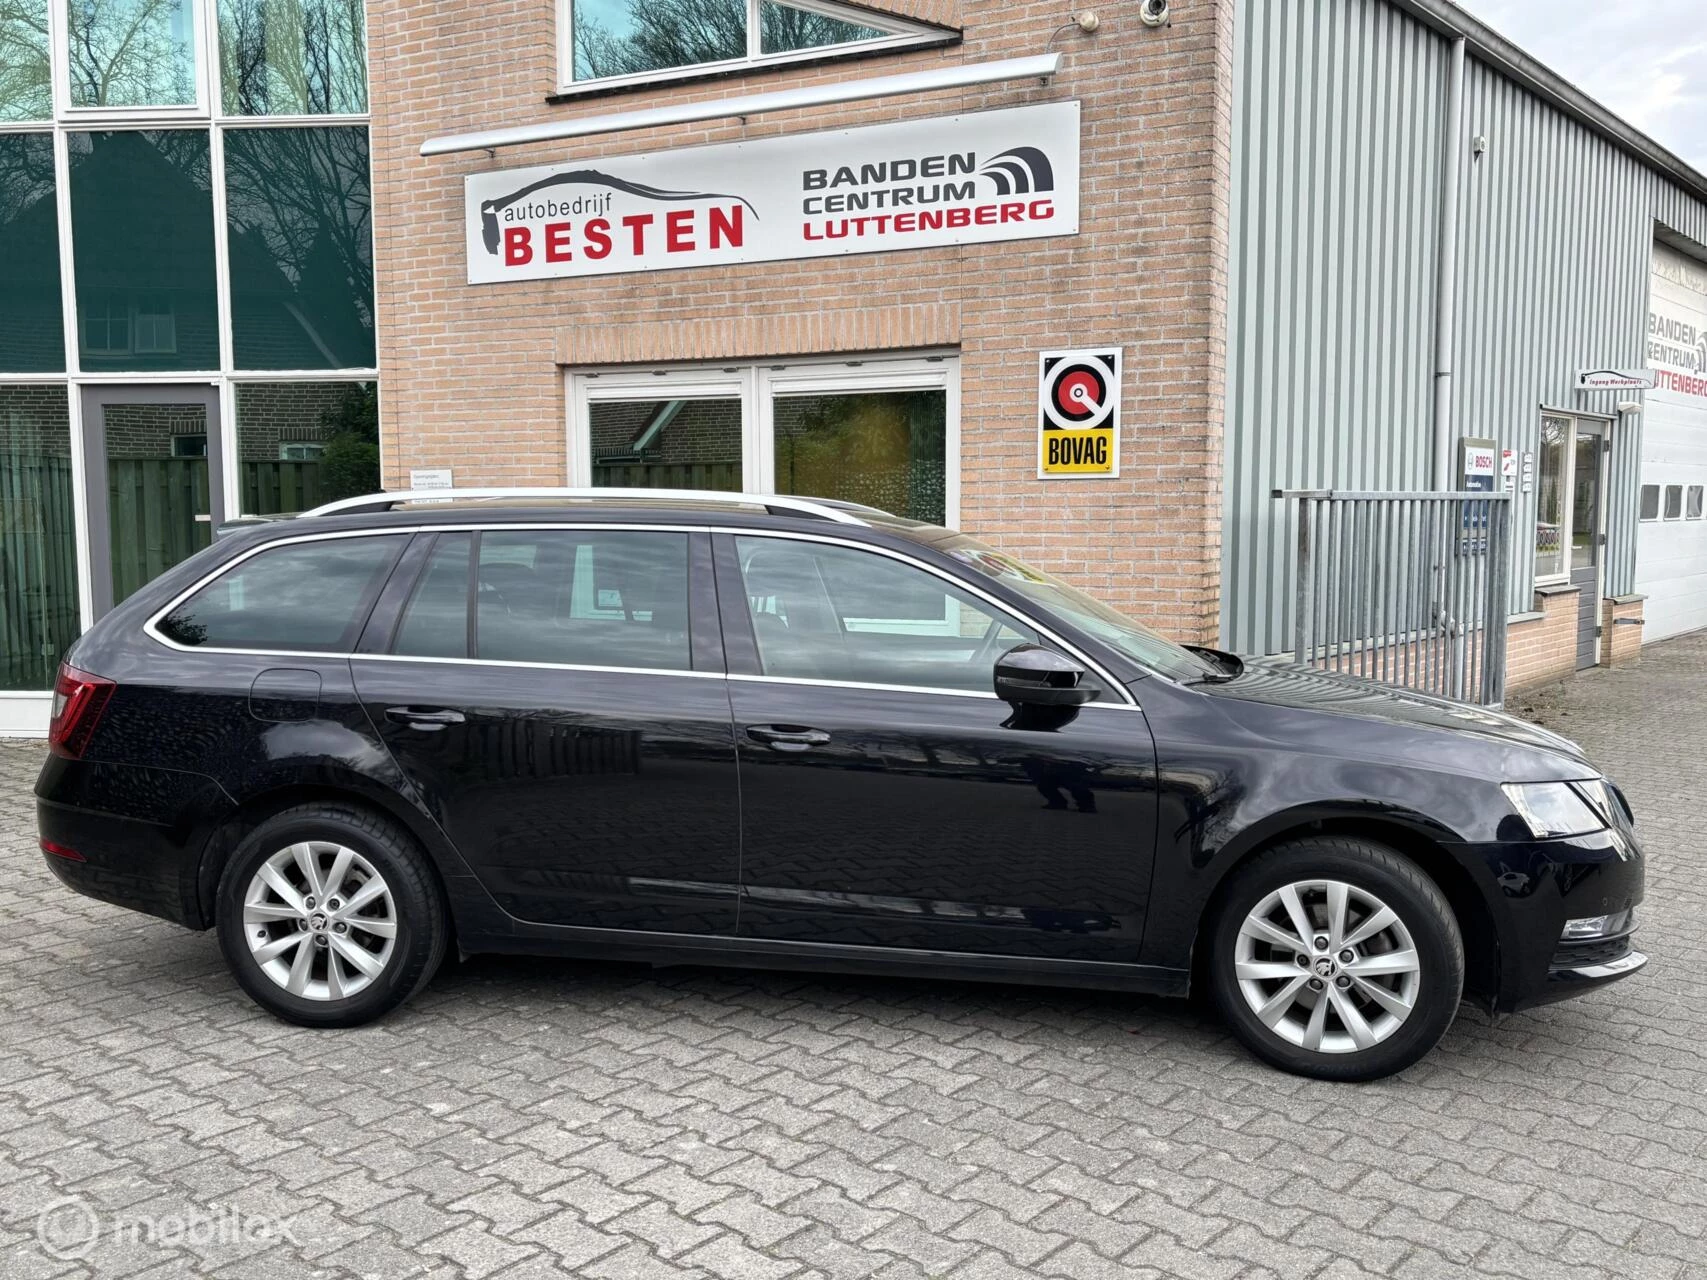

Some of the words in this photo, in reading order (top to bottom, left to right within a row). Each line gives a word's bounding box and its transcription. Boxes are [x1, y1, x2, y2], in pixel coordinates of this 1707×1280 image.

[802, 151, 976, 191] BANDEN
[504, 192, 613, 224] autobedrijf
[802, 180, 976, 216] CENTRUM
[504, 204, 744, 267] BESTEN
[802, 198, 1055, 241] LUTTENBERG
[1647, 312, 1697, 346] BANDEN
[1048, 436, 1107, 465] BOVAG
[1475, 455, 1493, 468] BOSCH
